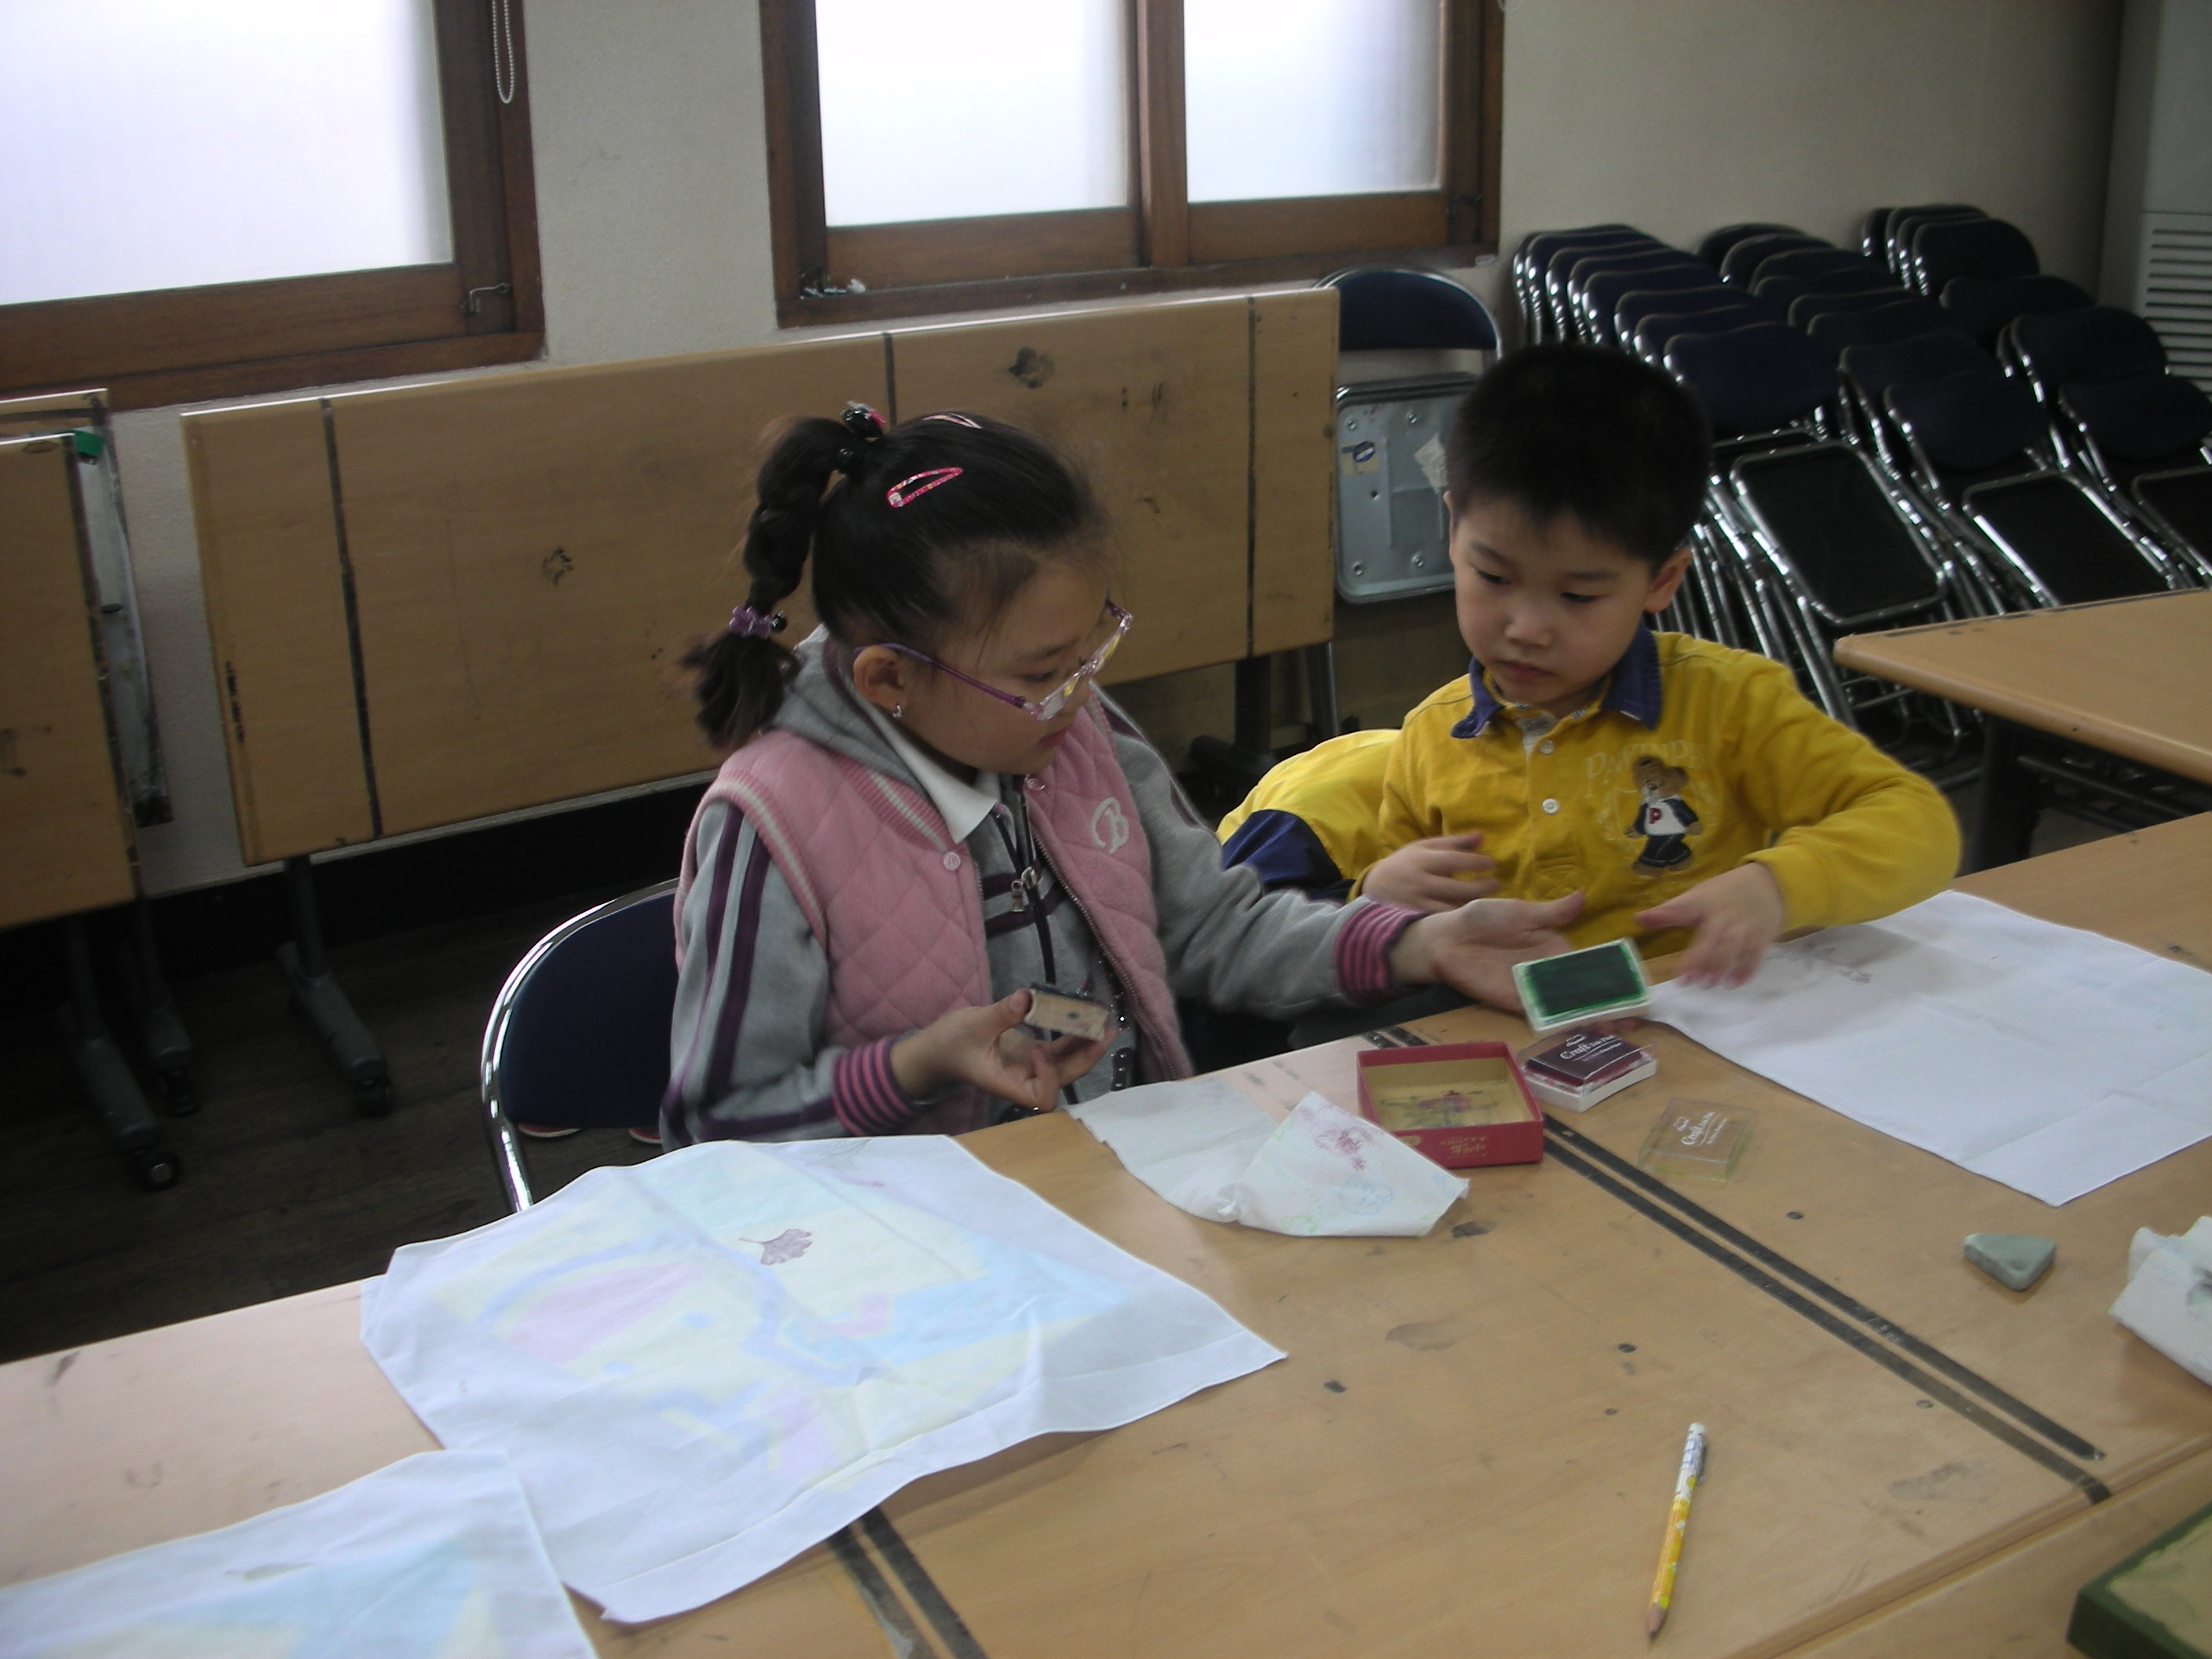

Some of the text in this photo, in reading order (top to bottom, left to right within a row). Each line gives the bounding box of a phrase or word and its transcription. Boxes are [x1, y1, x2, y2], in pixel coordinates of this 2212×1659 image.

[1649, 808, 1661, 825] P
[1090, 798, 1130, 854] B
[1560, 1043, 1591, 1059] Craft
[1681, 1126, 1703, 1145] Craft
